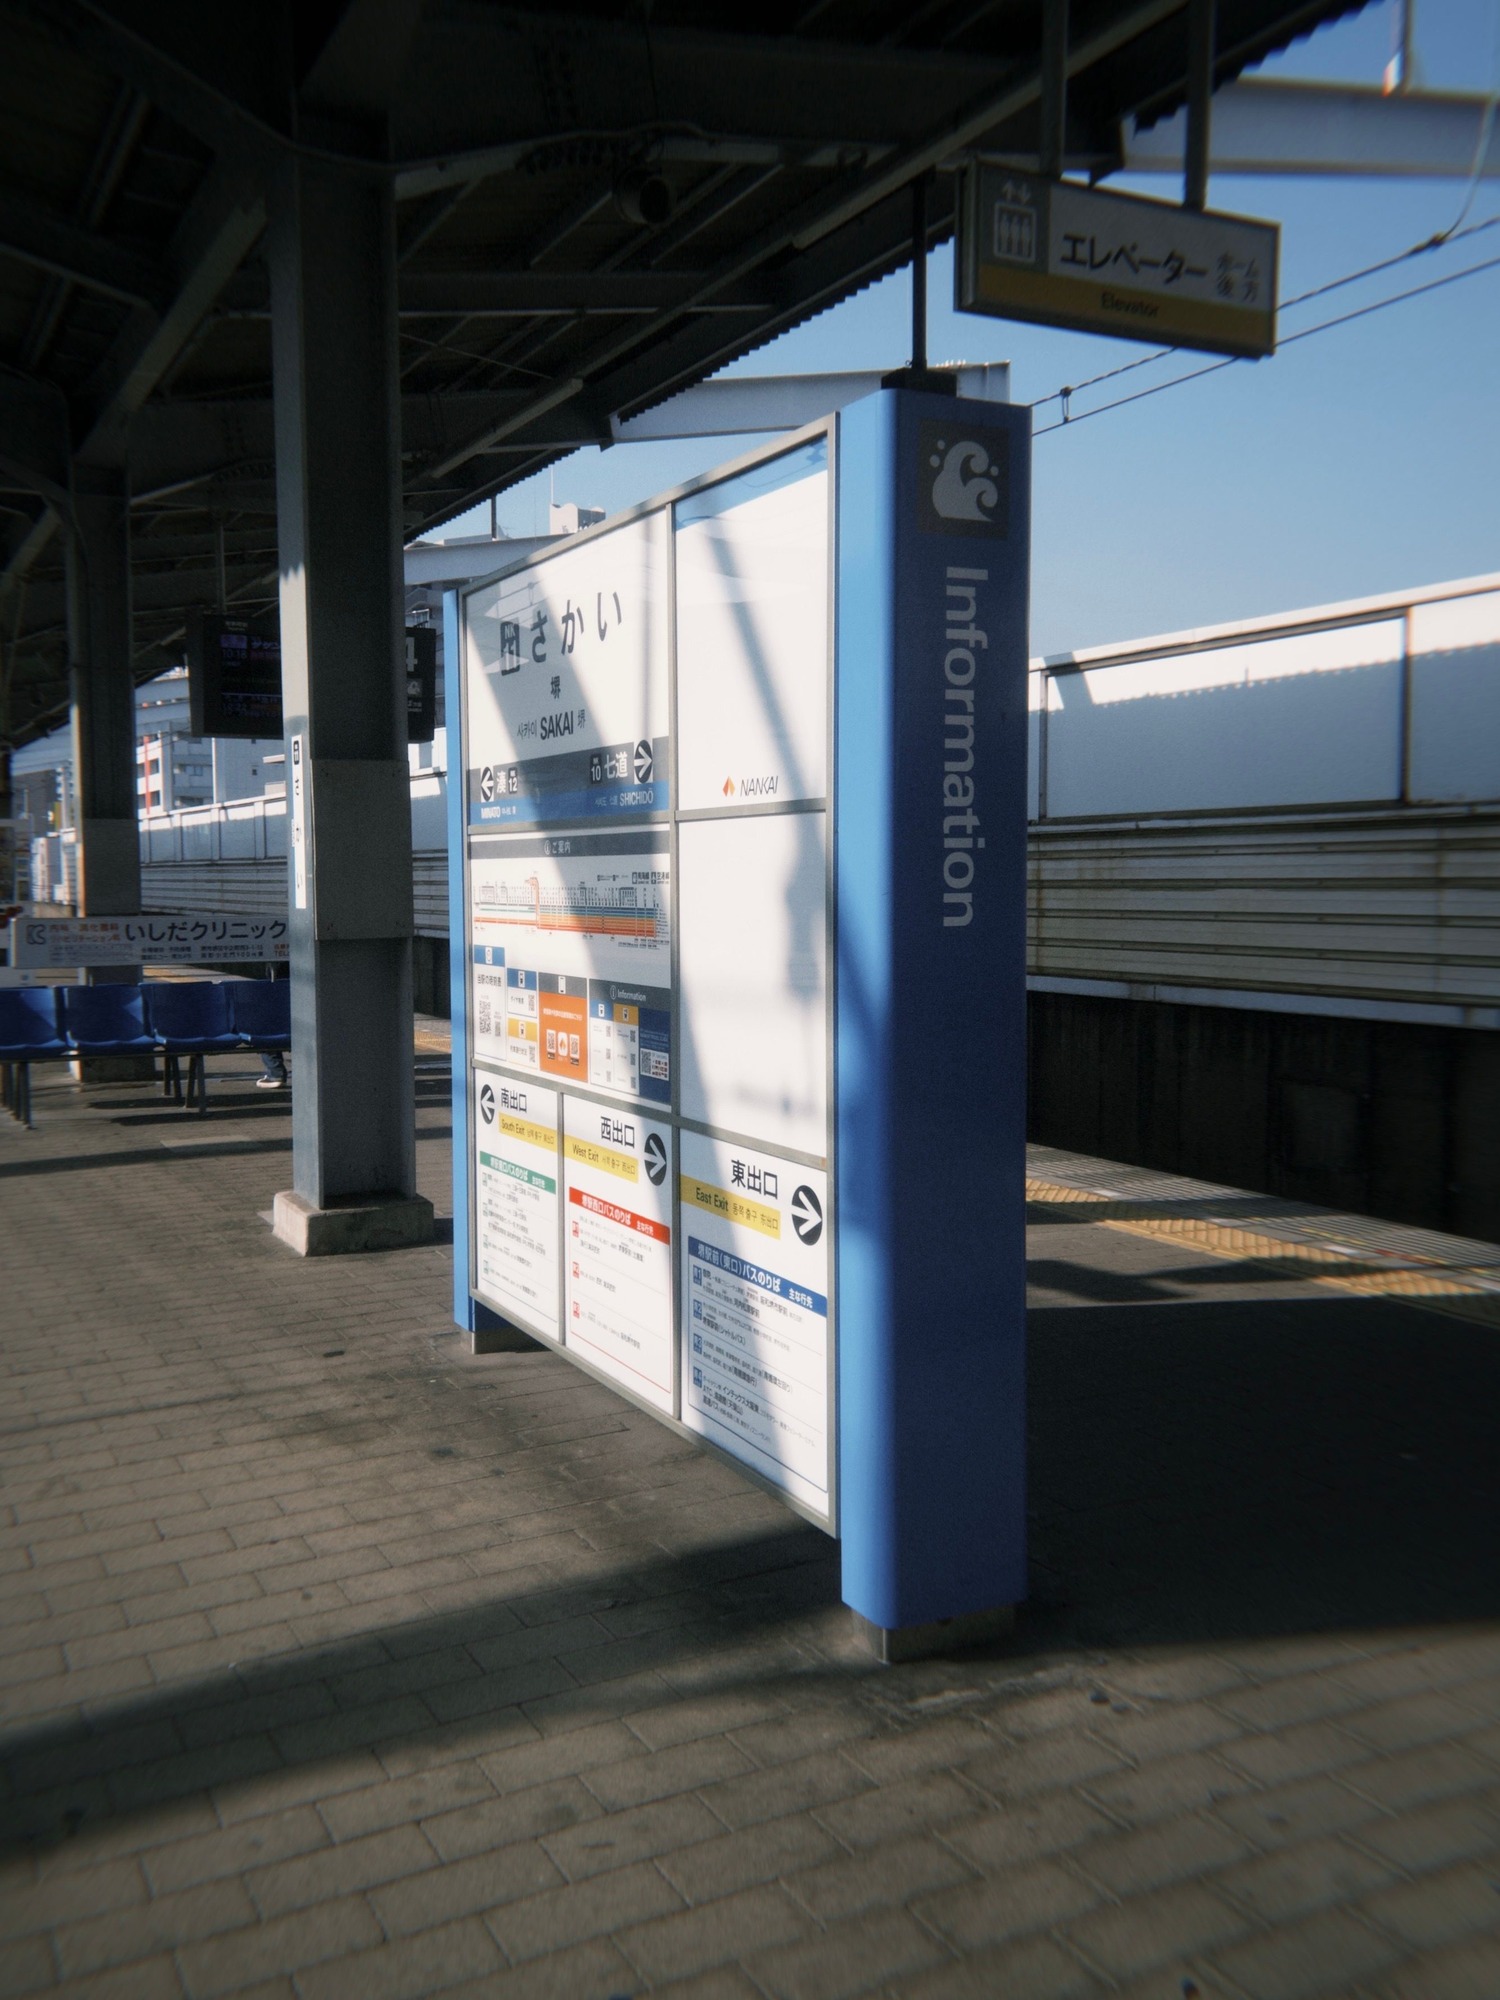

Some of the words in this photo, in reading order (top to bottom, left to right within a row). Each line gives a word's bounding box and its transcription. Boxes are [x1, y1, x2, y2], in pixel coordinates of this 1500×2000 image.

[1060, 232, 1208, 286] エレベーター
[1101, 291, 1160, 318] Elevator
[504, 624, 516, 637] NK
[530, 591, 622, 663] さかい
[504, 637, 517, 670] 11
[550, 675, 561, 699] 堺
[540, 711, 574, 740] SAKAI
[942, 566, 988, 927] Information
[590, 764, 602, 782] 10
[604, 752, 628, 778] 七道
[508, 777, 518, 793] 12
[740, 775, 779, 798] NANKAI
[552, 840, 571, 855] ご案内
[125, 920, 287, 942] いしだクリニック
[617, 988, 647, 1002] Information
[501, 1087, 527, 1113] 南出口
[501, 1119, 515, 1133] South
[515, 1123, 525, 1136] Exit
[600, 1116, 635, 1149] 西出口
[572, 1144, 587, 1158] West
[588, 1149, 599, 1162] Exit
[731, 1159, 778, 1200] 東出口
[695, 1187, 712, 1203] East
[714, 1194, 728, 1212] Exit
[788, 1288, 813, 1309] 主な行先
